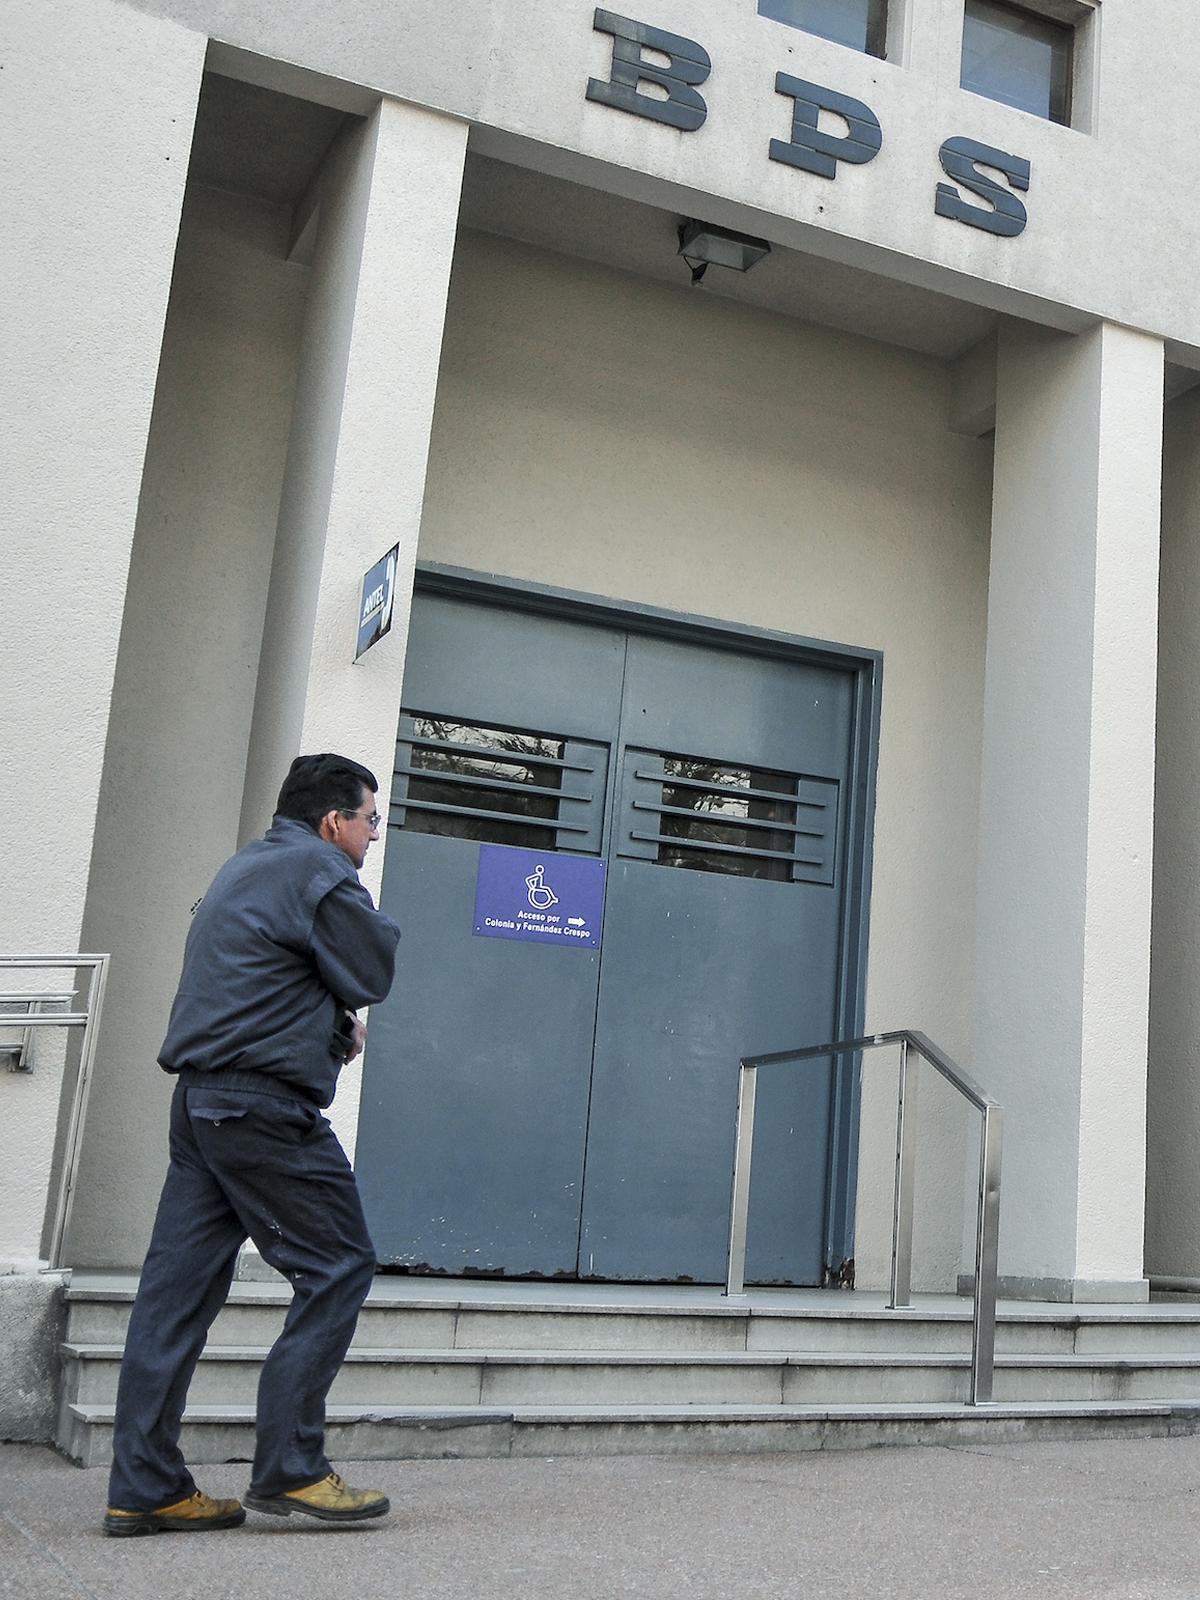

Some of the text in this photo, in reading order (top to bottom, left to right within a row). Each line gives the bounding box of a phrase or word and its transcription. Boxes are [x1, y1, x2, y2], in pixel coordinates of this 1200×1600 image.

[585, 7, 1031, 237] BPS
[362, 583, 384, 618] ANTEL
[485, 917, 591, 938] Colonia y Fernández Crespo
[518, 910, 561, 924] Acceso por
